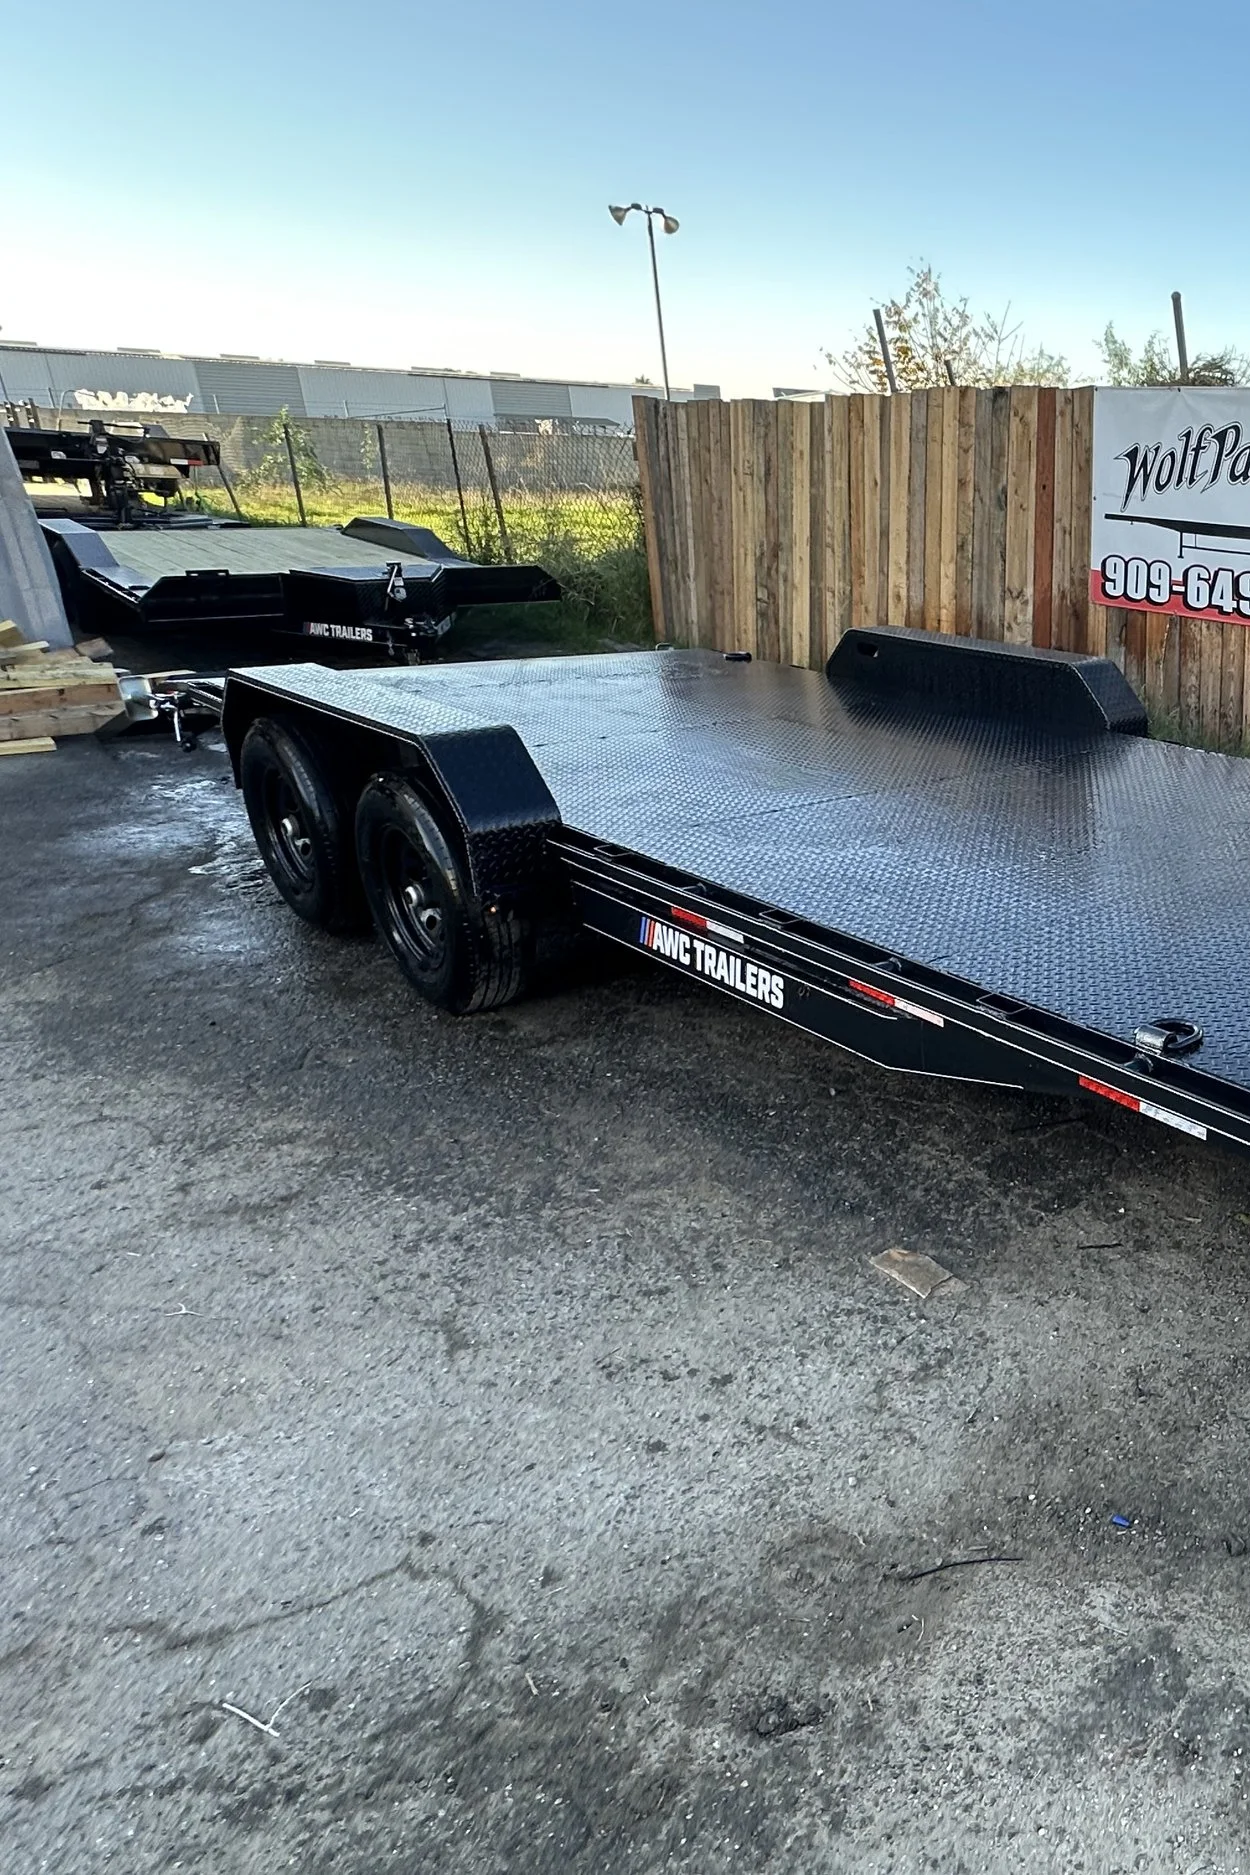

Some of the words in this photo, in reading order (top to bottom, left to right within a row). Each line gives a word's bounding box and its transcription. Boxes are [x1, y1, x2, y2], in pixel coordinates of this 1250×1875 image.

[309, 622, 330, 637] AWC
[330, 623, 373, 642] TRAILERS
[652, 921, 691, 966] AWC
[693, 938, 785, 1010] TRAILERS
